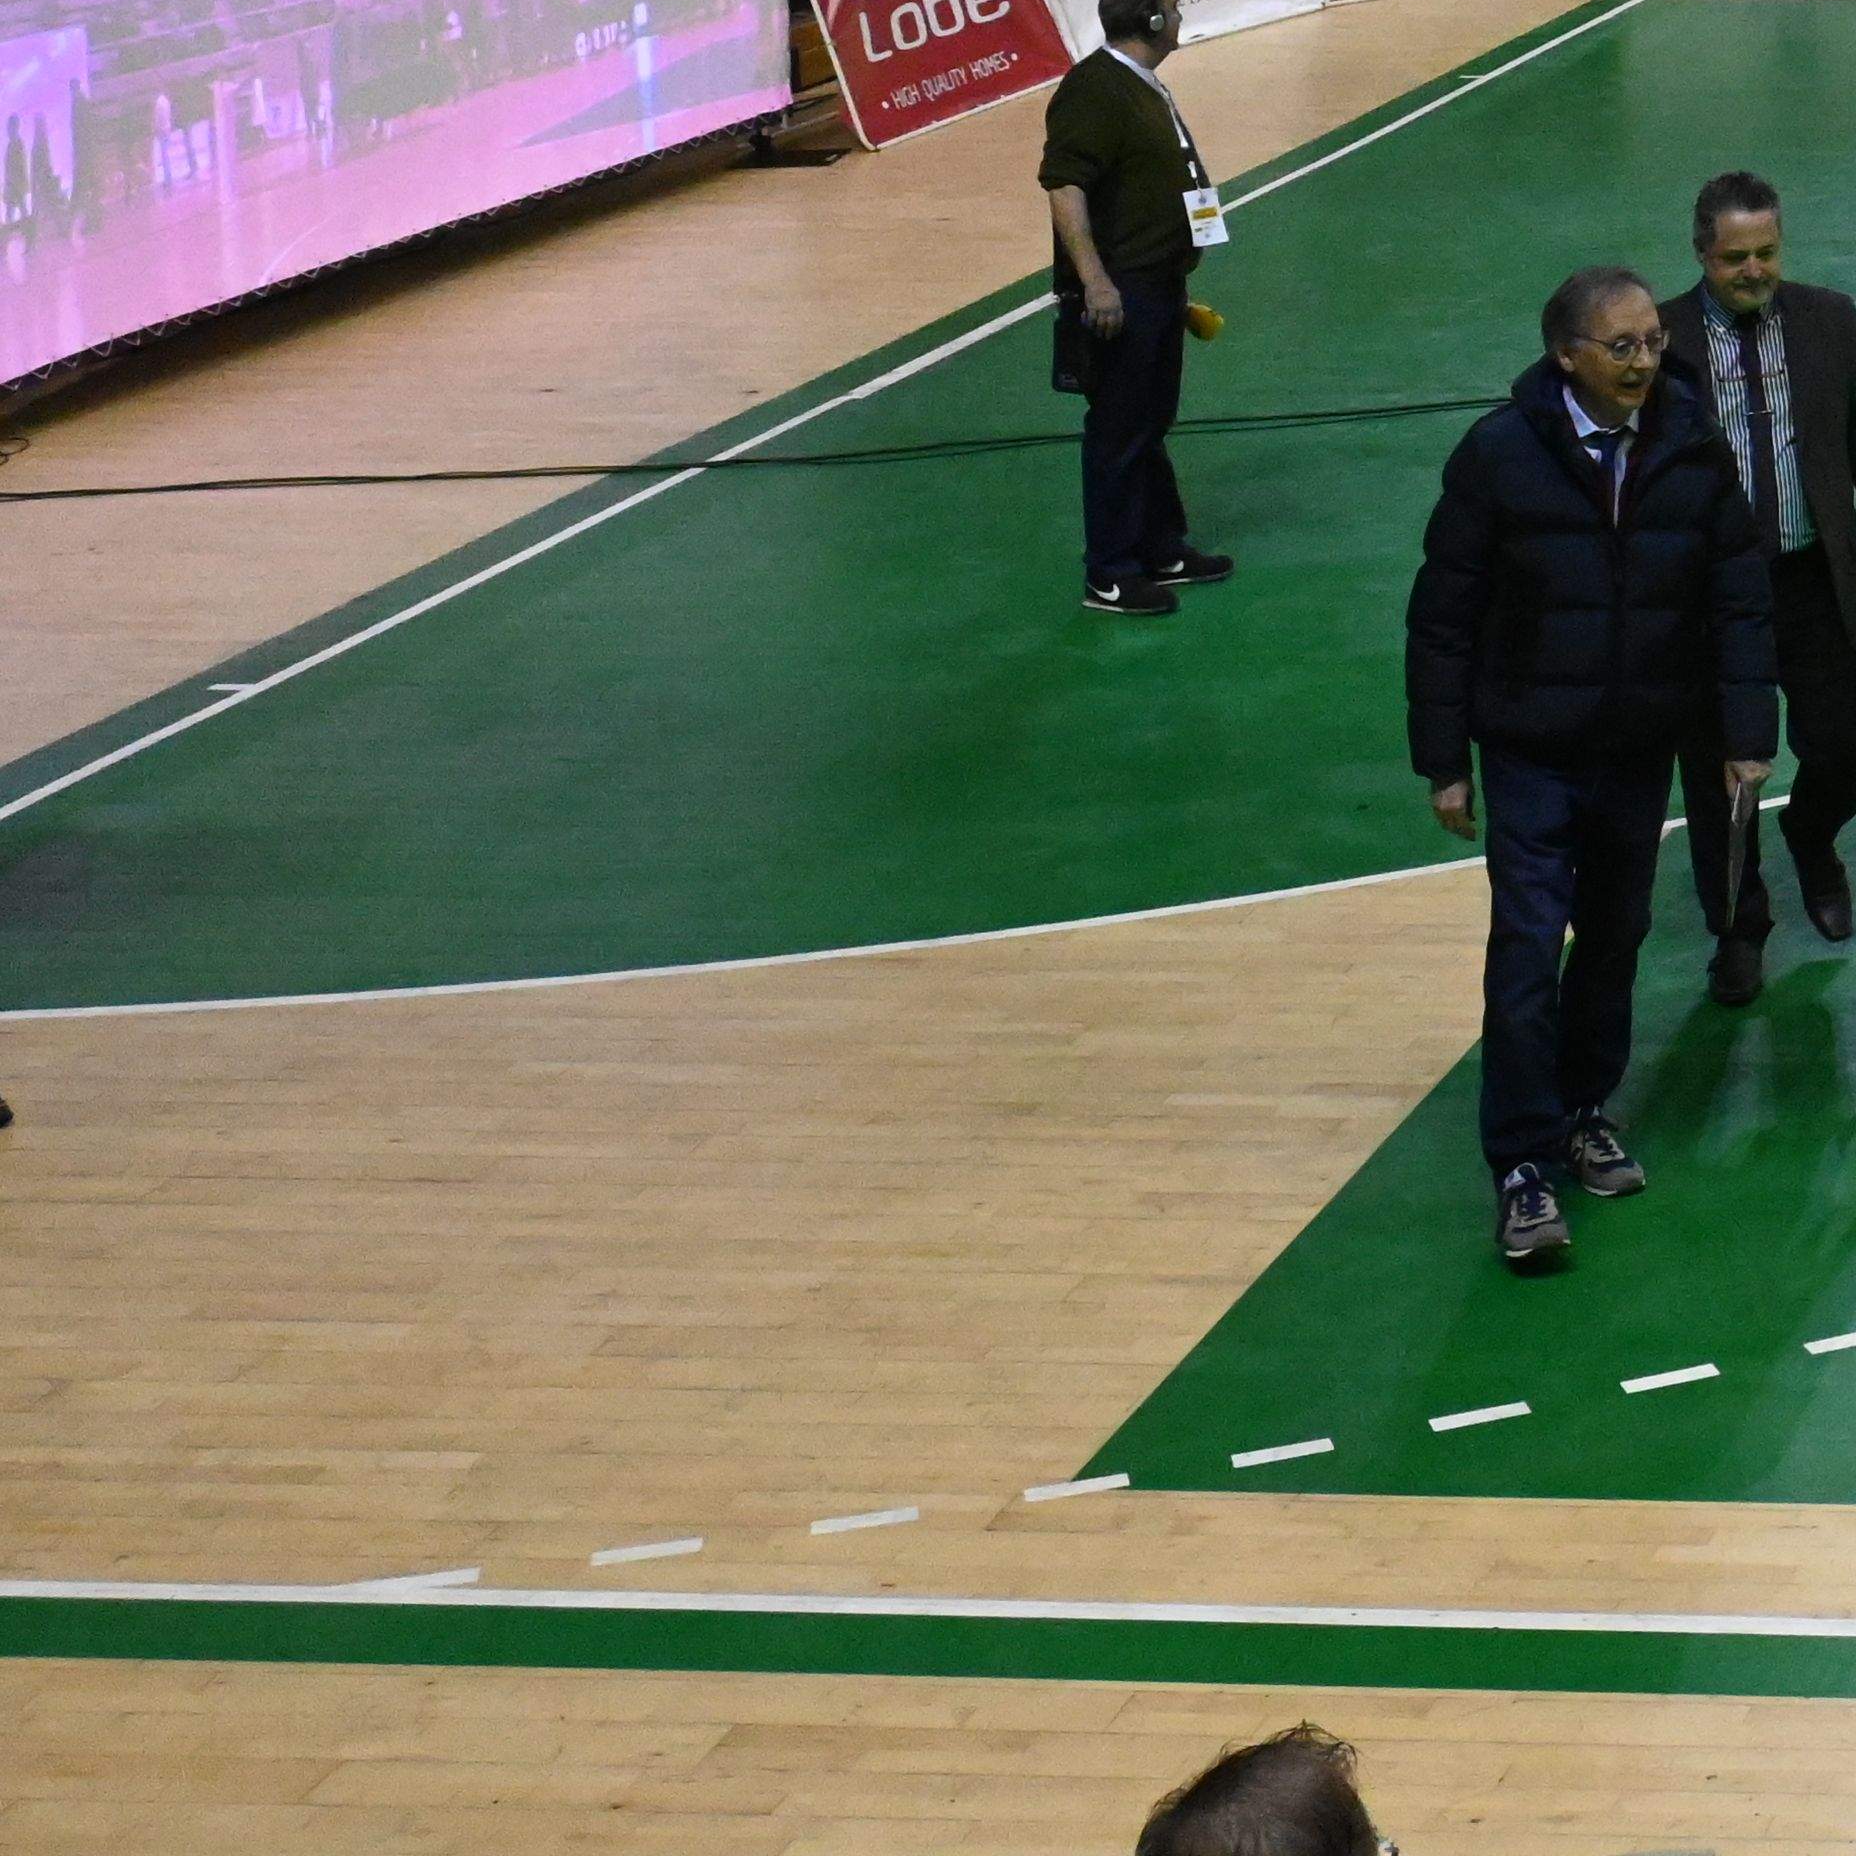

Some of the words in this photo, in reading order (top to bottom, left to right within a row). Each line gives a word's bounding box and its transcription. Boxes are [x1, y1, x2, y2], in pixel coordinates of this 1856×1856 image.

[890, 87, 921, 110] HIGH
[922, 67, 968, 101] QUALITY
[970, 50, 1011, 81] HOMES
